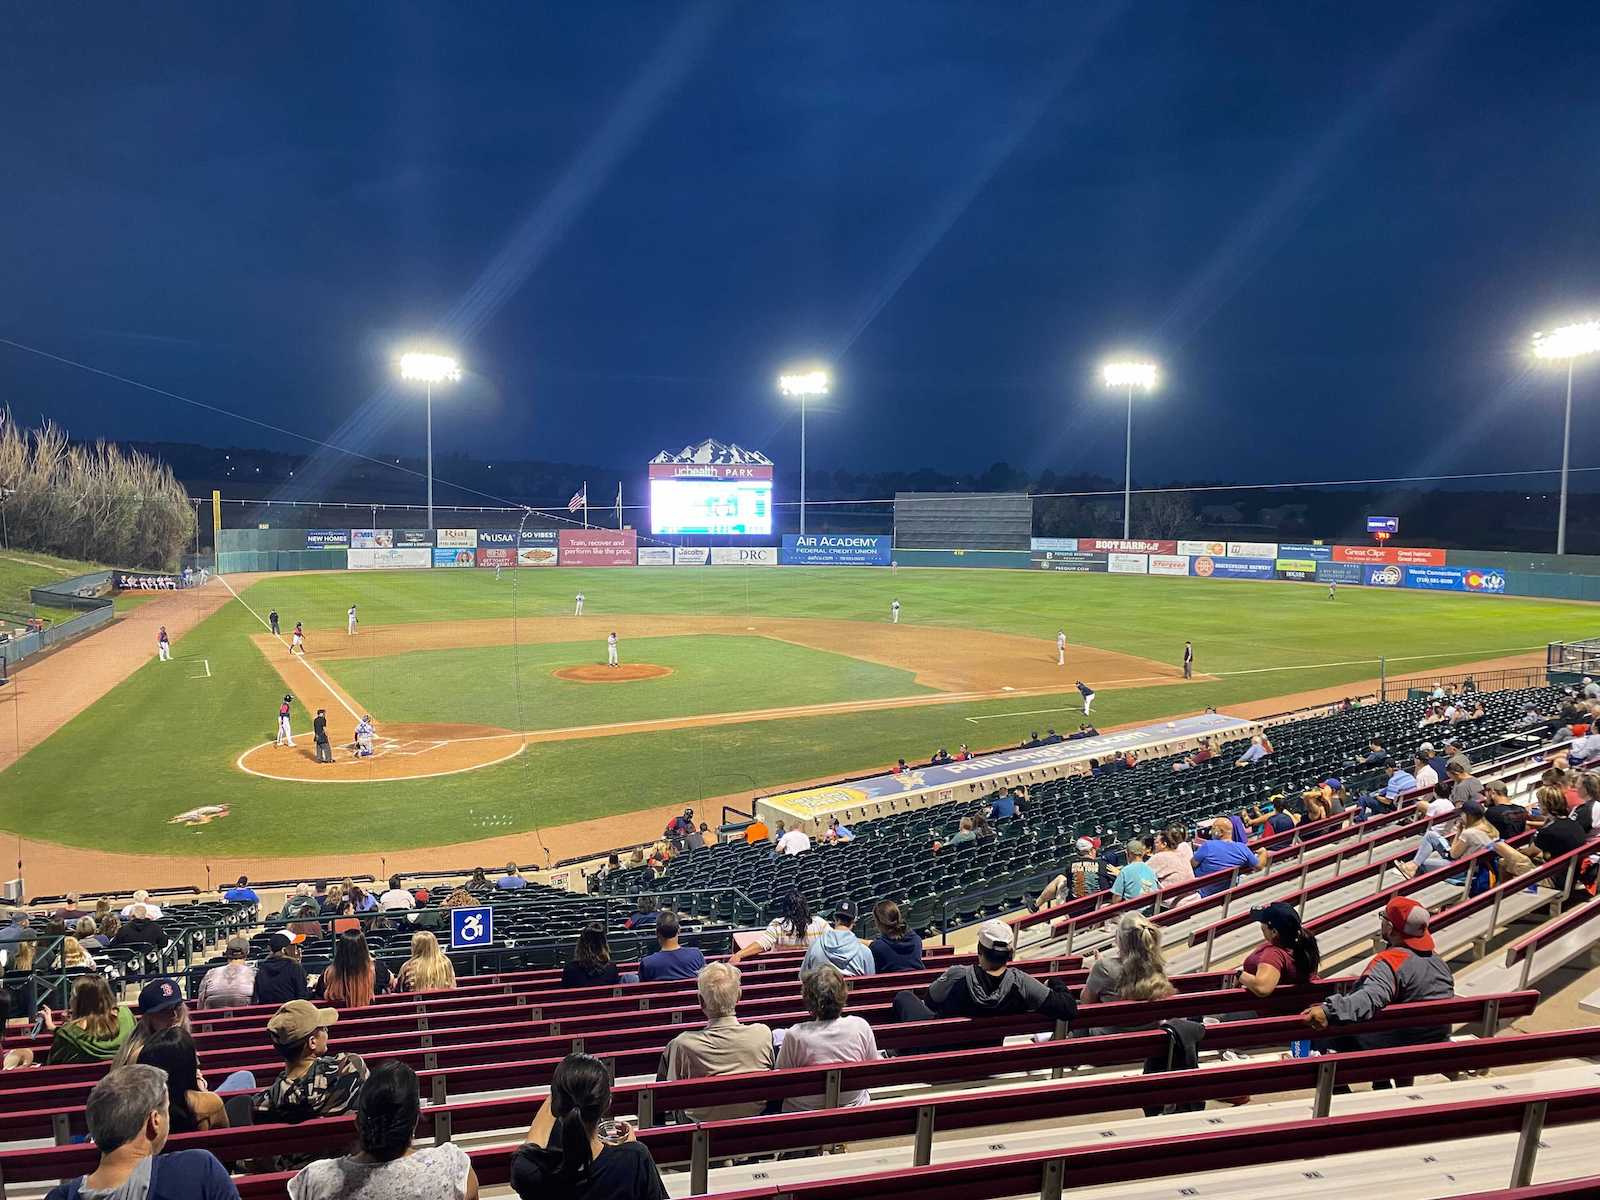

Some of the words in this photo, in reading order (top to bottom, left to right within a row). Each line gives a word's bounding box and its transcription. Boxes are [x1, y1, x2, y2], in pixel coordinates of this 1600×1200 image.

[674, 465, 718, 477] uchealth
[725, 469, 753, 477] PARK
[491, 533, 514, 542] USAA
[796, 536, 817, 546] AIR
[820, 536, 878, 547] ACADEMY
[1095, 540, 1119, 549] BOOT
[564, 548, 592, 556] perform
[739, 550, 768, 560] DRC
